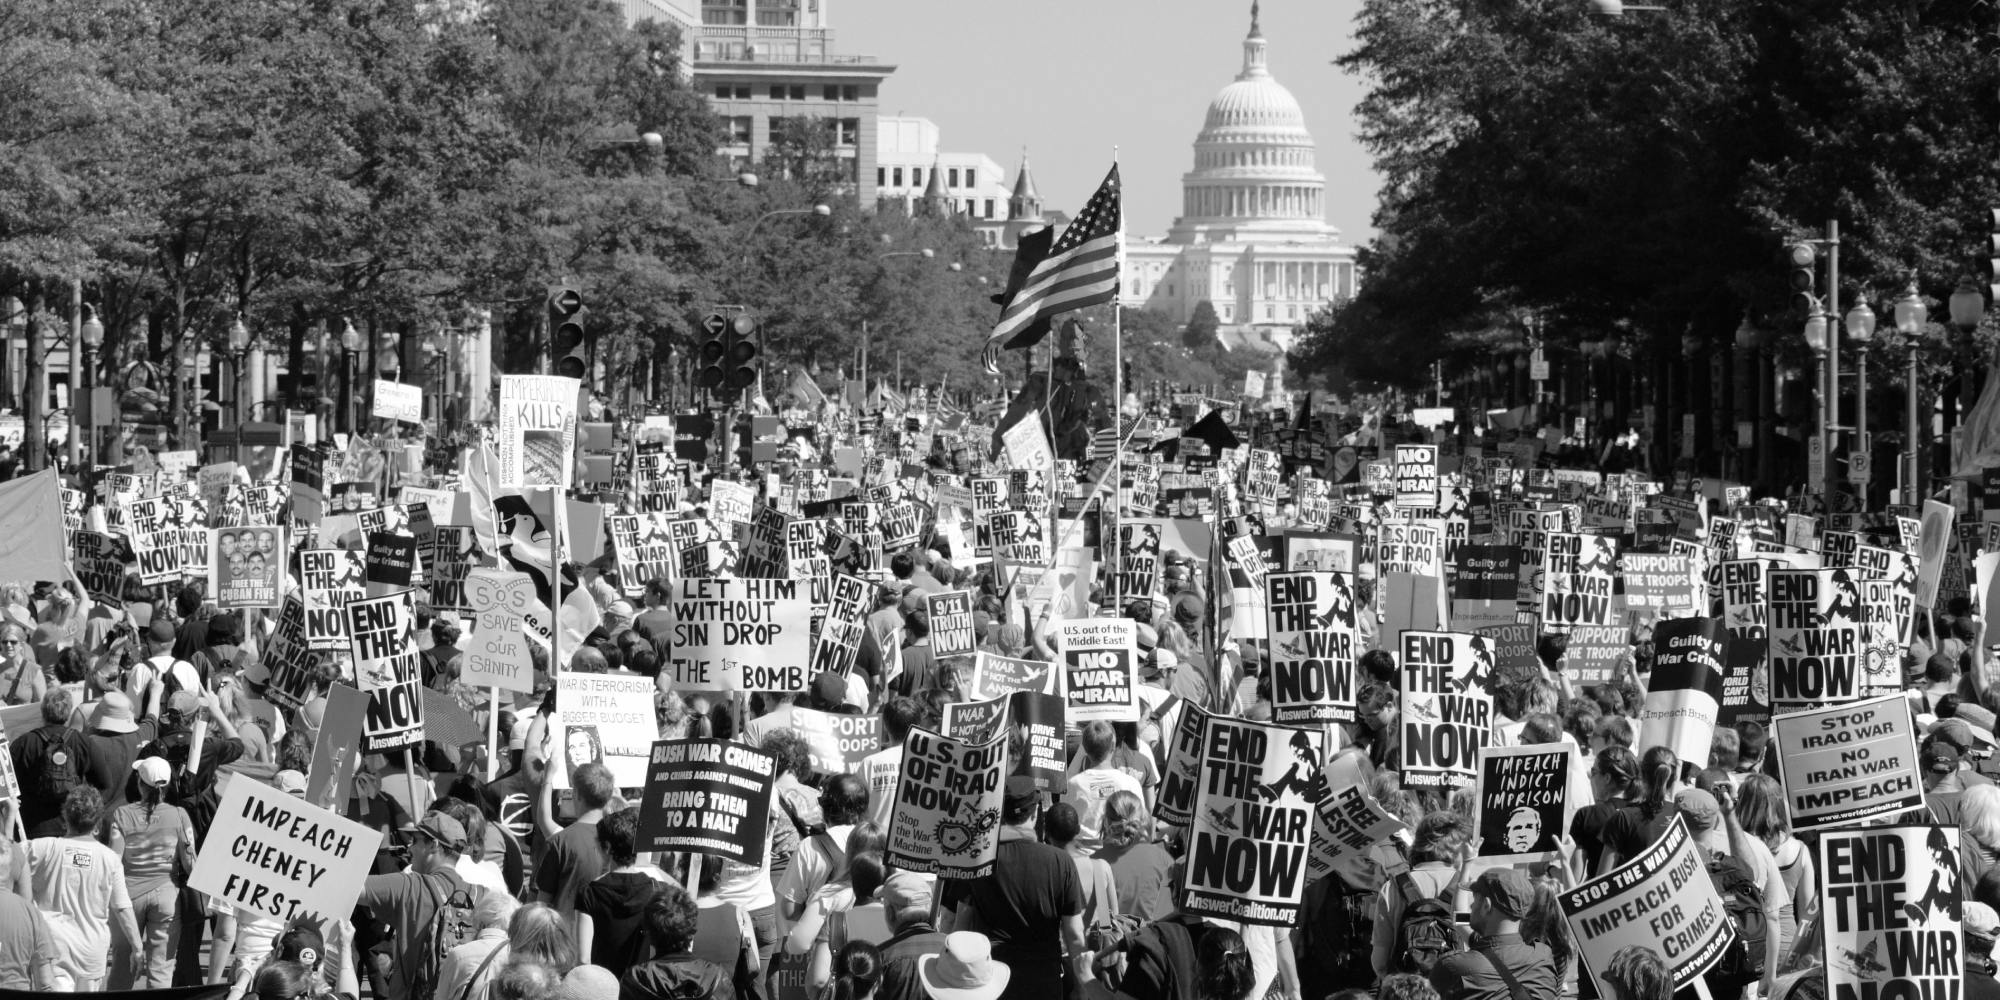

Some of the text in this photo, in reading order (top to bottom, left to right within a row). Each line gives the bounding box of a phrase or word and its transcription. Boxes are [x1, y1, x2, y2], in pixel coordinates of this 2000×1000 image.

[517, 402, 562, 428] KILLS
[638, 456, 659, 469] END
[1252, 450, 1269, 462] END
[1398, 449, 1431, 463] NO
[246, 490, 268, 501] END
[974, 480, 998, 495] END
[131, 502, 156, 518] END
[641, 494, 677, 512] NOW
[844, 506, 869, 519] END
[360, 510, 386, 528] END
[614, 516, 639, 533] END
[991, 514, 1017, 530] END
[1512, 512, 1561, 530] U.S. OUT
[1713, 520, 1735, 536] END
[152, 528, 179, 548] WAR
[789, 524, 815, 541] END
[882, 517, 917, 544] NOW
[1410, 528, 1436, 546] OUT
[1512, 530, 1530, 547] OF
[373, 544, 406, 556] Guilty of
[1550, 535, 1582, 555] END
[303, 552, 335, 571] END
[367, 556, 411, 568] War Crimes
[1381, 545, 1432, 565] OF IRAQ
[1467, 558, 1510, 569] Guilty of
[1624, 556, 1687, 572] SUPPORT
[231, 579, 265, 588] FREE THE
[1459, 570, 1515, 580] War Crimes
[1625, 574, 1689, 587] THE TROOPS
[220, 587, 275, 601] CUBAN FIVE
[476, 586, 527, 607] SOS
[683, 579, 730, 599] LET
[837, 580, 863, 601] END
[1270, 576, 1317, 605] END
[1771, 574, 1818, 601] END
[1870, 584, 1892, 603] OUT
[935, 597, 964, 616] 9/11
[1627, 594, 1690, 606] END THE WAR
[352, 601, 397, 633] END
[674, 601, 776, 623] WITHOUT
[482, 613, 520, 632] SAVE
[931, 613, 971, 631] TRUTH
[1064, 625, 1128, 635] U.S. out of the
[674, 624, 782, 647] SIN DROP
[1068, 636, 1125, 646] Middle East!
[1305, 631, 1351, 659] WAR
[1568, 627, 1629, 645] SUPPORT
[1669, 634, 1722, 655] Guilty of
[1804, 627, 1855, 655] WAR
[485, 637, 518, 657] OUR
[1405, 635, 1454, 665] END
[470, 654, 520, 679] SANITY
[989, 658, 1015, 673] WAR
[1078, 652, 1118, 670] NO
[1657, 653, 1684, 665] War
[673, 658, 711, 684] THE
[742, 665, 803, 691] BOMB
[1073, 670, 1125, 687] WAR
[1733, 667, 1749, 676] THE
[1773, 655, 1856, 700] NOW
[559, 679, 652, 694] WAR IS TERRORISM
[1274, 660, 1352, 703] NOW
[1724, 686, 1749, 696] CAN'T
[581, 695, 617, 708] WITH A
[1069, 688, 1128, 703] ON IRAN
[1723, 696, 1749, 706] WAIT!
[562, 712, 645, 725] BIGGER BUDGET
[958, 707, 984, 722] WAR
[1276, 705, 1355, 722] AnswerCoalition.org
[1438, 695, 1490, 728] WAR
[1820, 710, 1876, 731] STOP
[1031, 724, 1055, 737] DRIVE
[1801, 722, 1894, 749] IRAQ WAR
[1031, 735, 1063, 750] OUT THE
[1031, 746, 1054, 758] BUSH
[1208, 723, 1267, 765] END
[652, 743, 774, 778] BUSH WAR CRIMES
[910, 733, 1006, 772] U.S. OUT
[1841, 748, 1870, 764] NO
[1031, 757, 1065, 771] REGIME!
[1495, 754, 1561, 774] IMPEACH
[1806, 757, 1900, 784] IRAN WAR
[655, 771, 763, 793] AND CRIMES AGAINST HUMANITY
[906, 758, 999, 796] OF IRAQ
[1205, 759, 1264, 803] THE
[1500, 772, 1555, 791] INDICT
[902, 779, 961, 819] NOW
[1487, 788, 1564, 809] IMPRISON
[1796, 775, 1913, 810] IMPEACH
[661, 791, 748, 817] BRING THEM
[1317, 773, 1376, 850] PALESTINE
[1338, 785, 1381, 830] FREE
[242, 796, 353, 858] IMPEACH
[666, 811, 740, 834] TO A HALT
[898, 811, 920, 829] Stop
[1242, 802, 1308, 844] WAR
[896, 824, 932, 843] the War
[654, 837, 744, 856] WWW.BUSHCOMMISSION.ORG
[893, 837, 933, 855] Machine
[231, 834, 327, 889] CHENEY
[1191, 831, 1305, 898] NOW
[1571, 825, 1684, 908] STOP THE WAR NOW!
[1826, 834, 1906, 885] END
[222, 874, 302, 921] FIRST
[1579, 849, 1698, 941] IMPEACH BUSH
[1185, 890, 1297, 924] AnswerCoalition.org
[1649, 903, 1685, 938] FOR
[1661, 898, 1718, 959] CRIMES!
[1885, 930, 1959, 977] WAR
